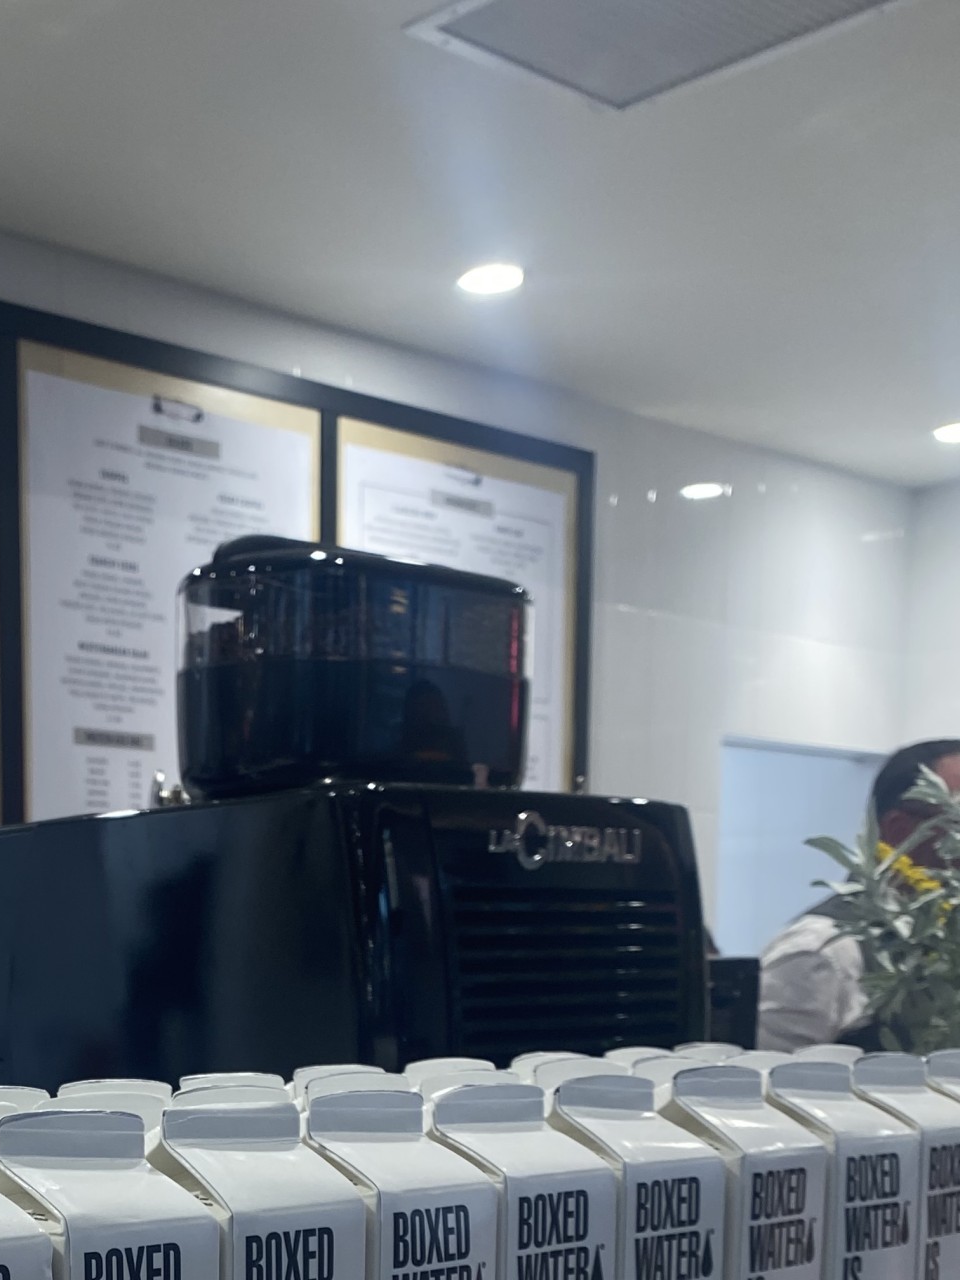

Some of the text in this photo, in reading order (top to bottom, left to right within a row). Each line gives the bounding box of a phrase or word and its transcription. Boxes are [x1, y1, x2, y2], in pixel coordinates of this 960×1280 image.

[636, 1176, 700, 1233] BOXED
[751, 1167, 806, 1221] BOXED
[846, 1152, 900, 1203] BOXED
[393, 1204, 470, 1269] BOXED
[518, 1189, 589, 1250] BOXED
[749, 1218, 806, 1273] WATER
[844, 1202, 900, 1253] WATER
